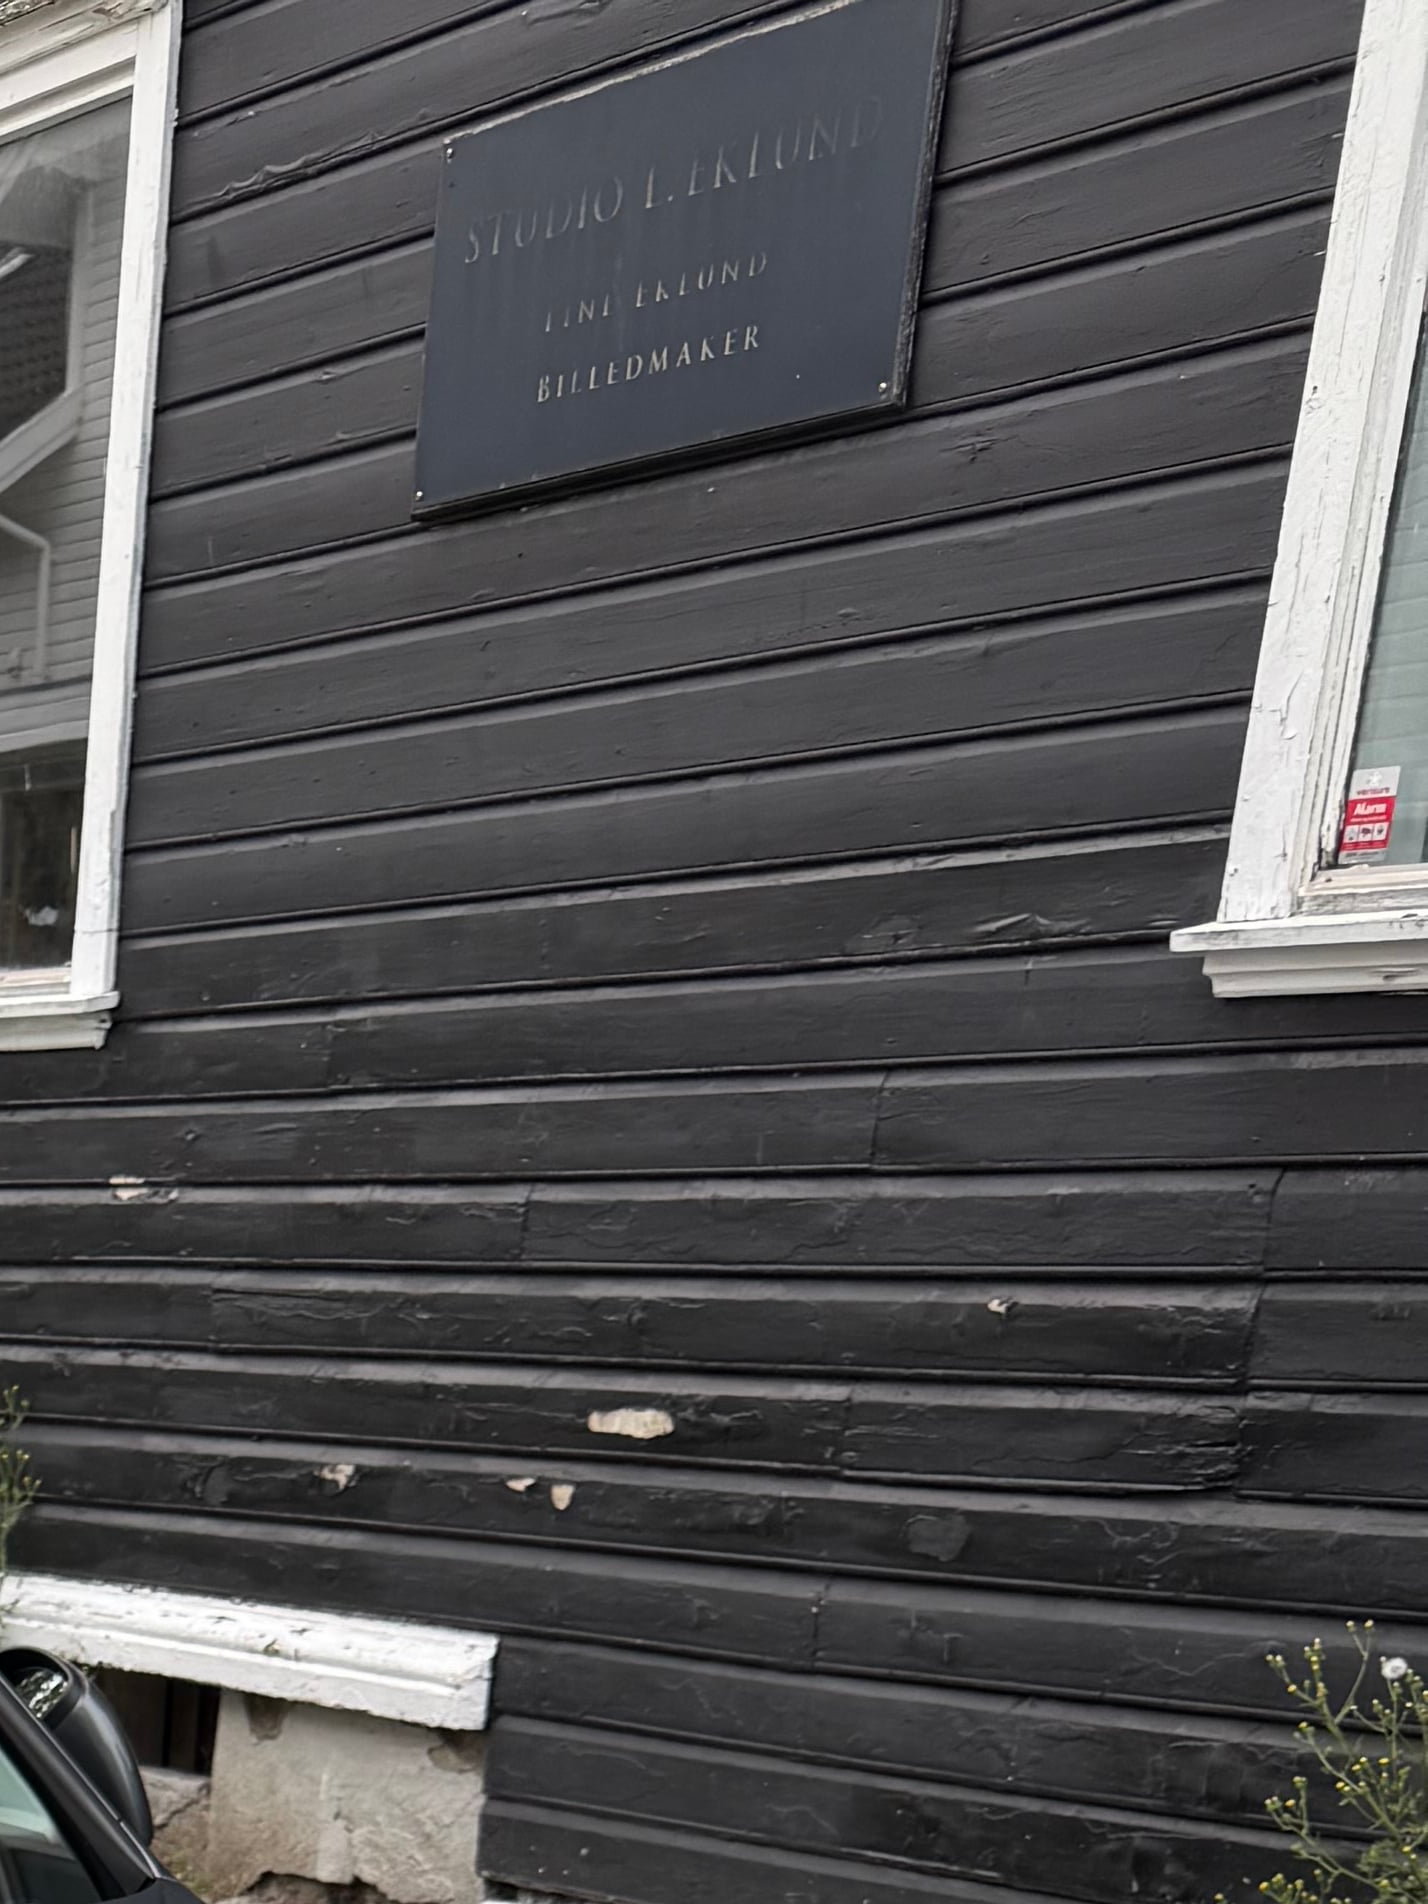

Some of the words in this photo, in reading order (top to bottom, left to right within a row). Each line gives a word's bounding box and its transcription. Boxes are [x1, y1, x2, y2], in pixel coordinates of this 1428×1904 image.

[464, 175, 624, 264] STUDIO
[688, 98, 883, 196] EKLUND
[635, 251, 767, 308] EKLUND
[537, 324, 760, 403] BILLEDMAKER
